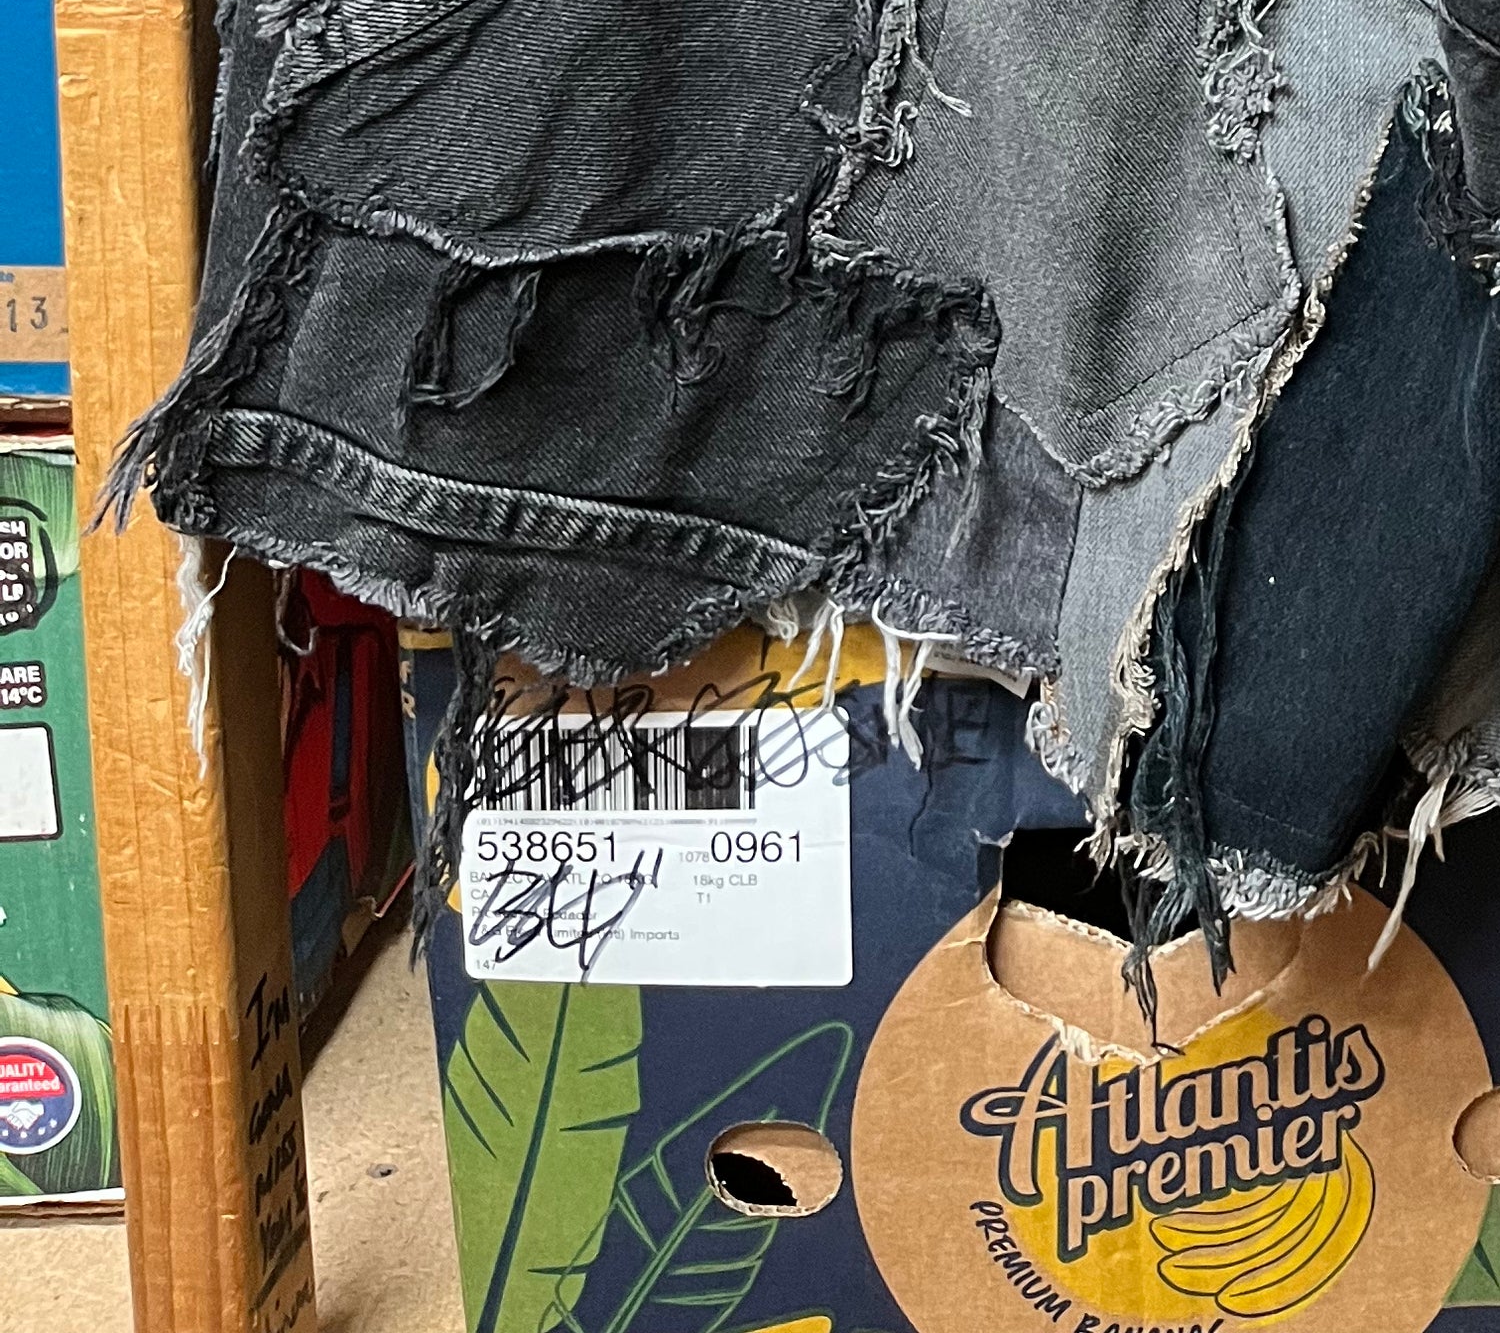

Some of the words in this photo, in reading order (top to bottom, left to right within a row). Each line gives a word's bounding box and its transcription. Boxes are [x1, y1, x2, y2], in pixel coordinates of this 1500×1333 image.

[477, 831, 616, 862] 538651
[679, 851, 709, 863] 1078
[711, 831, 802, 862] 0961
[693, 875, 724, 888] 18kg
[729, 874, 758, 886] CLB
[630, 929, 680, 942] Imports
[967, 1017, 1381, 1199] Atlantis
[1064, 1104, 1357, 1254] premier
[970, 1200, 1072, 1323] PREMIUM
